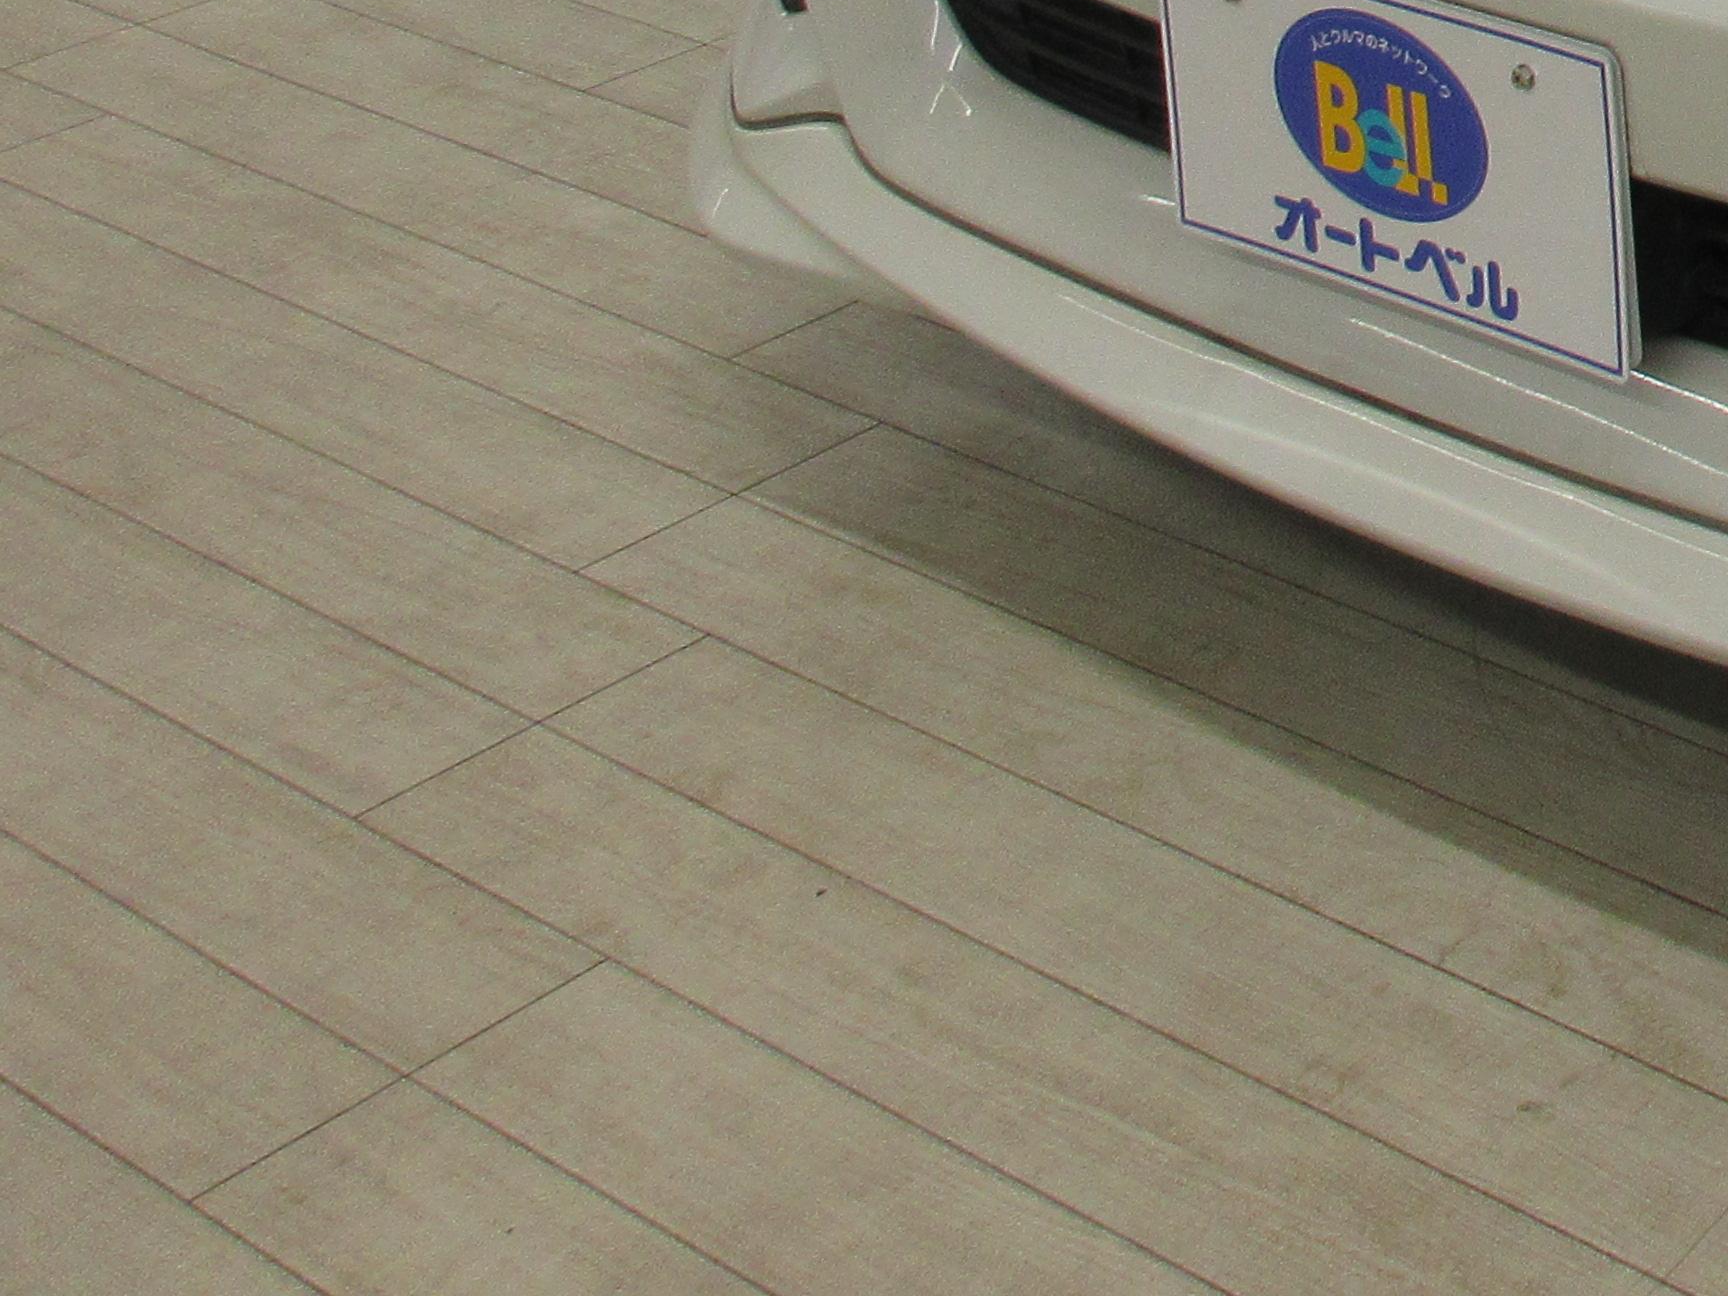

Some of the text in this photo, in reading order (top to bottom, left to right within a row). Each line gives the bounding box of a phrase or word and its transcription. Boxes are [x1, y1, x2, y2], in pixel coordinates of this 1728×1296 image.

[1274, 194, 1519, 321] オートベル
